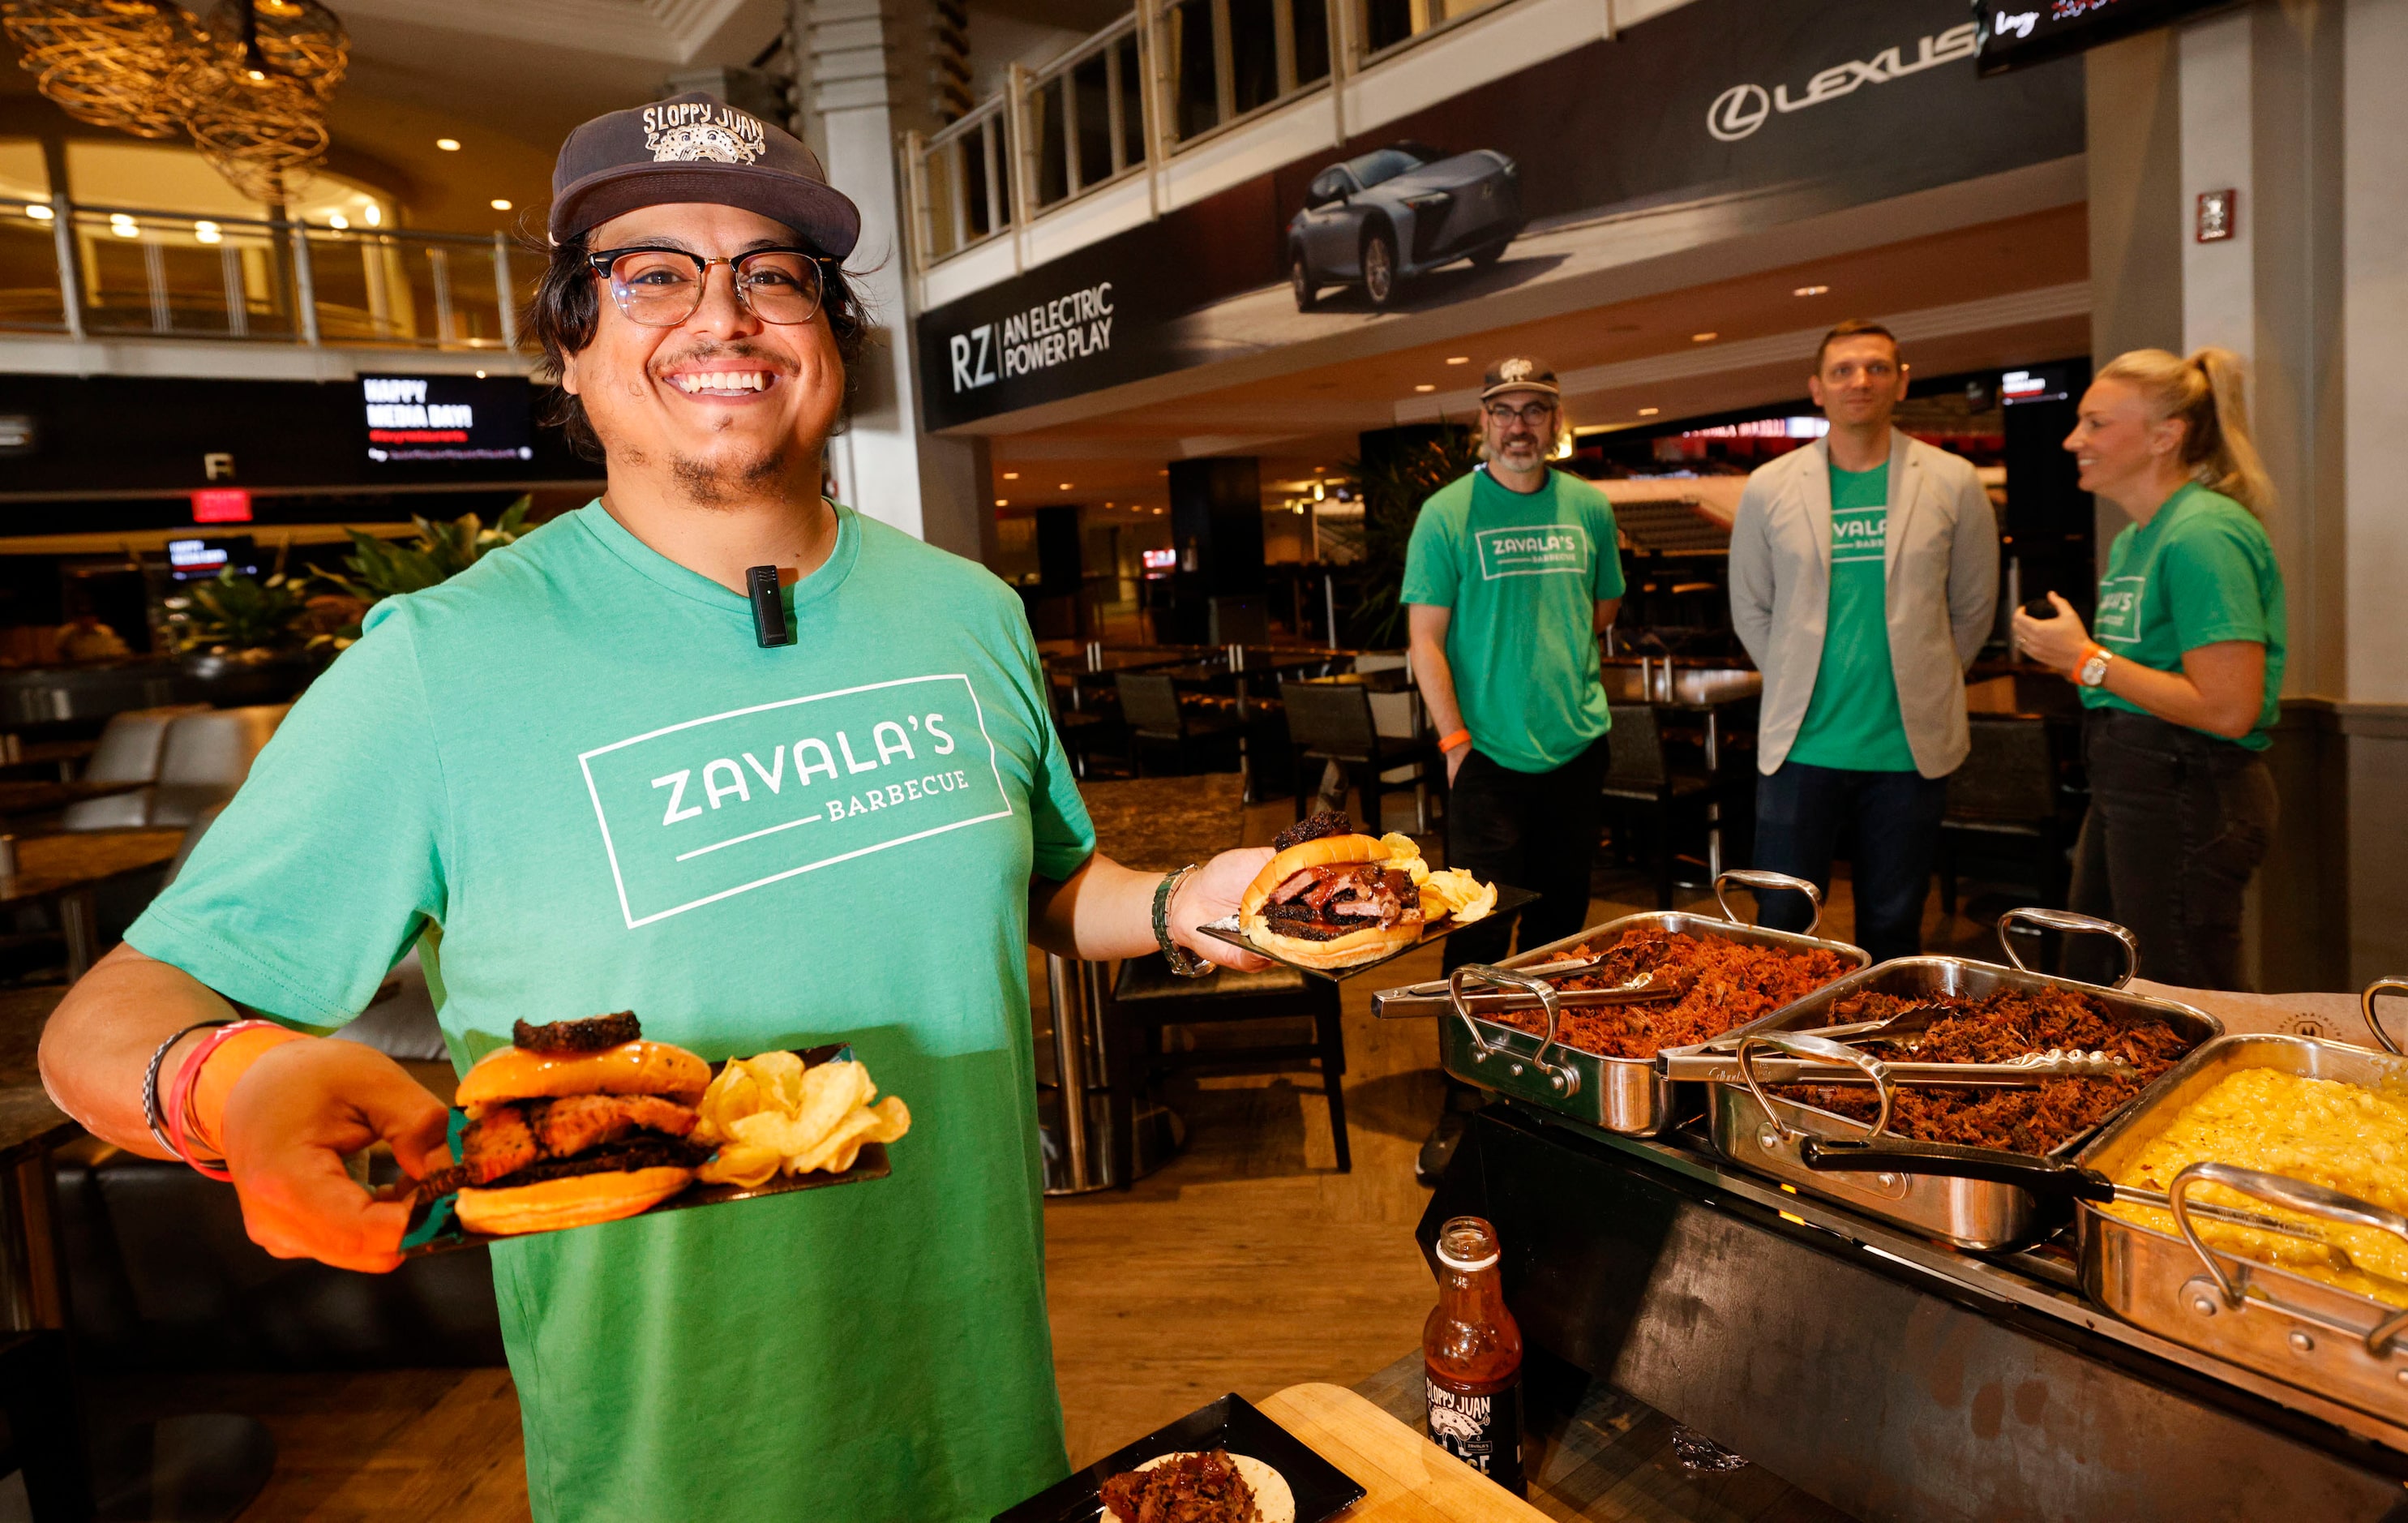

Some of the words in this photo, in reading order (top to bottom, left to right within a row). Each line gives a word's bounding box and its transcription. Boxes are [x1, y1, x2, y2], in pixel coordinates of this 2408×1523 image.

[1774, 21, 1977, 113] LEXUS
[643, 103, 712, 135] SLOPPY
[715, 108, 765, 141] JUAN
[1003, 311, 1029, 347] AN
[1030, 281, 1114, 338] ELECTRIC
[950, 324, 996, 393] RZ
[1005, 332, 1067, 379] POWER
[1067, 316, 1112, 359] PLAY
[1492, 535, 1575, 556] ZAVALA'S
[651, 713, 955, 826] ZAVALA'S
[825, 770, 969, 822] BARBECUE
[1426, 1377, 1455, 1409] SLOPPY
[1456, 1396, 1491, 1419] JUAN
